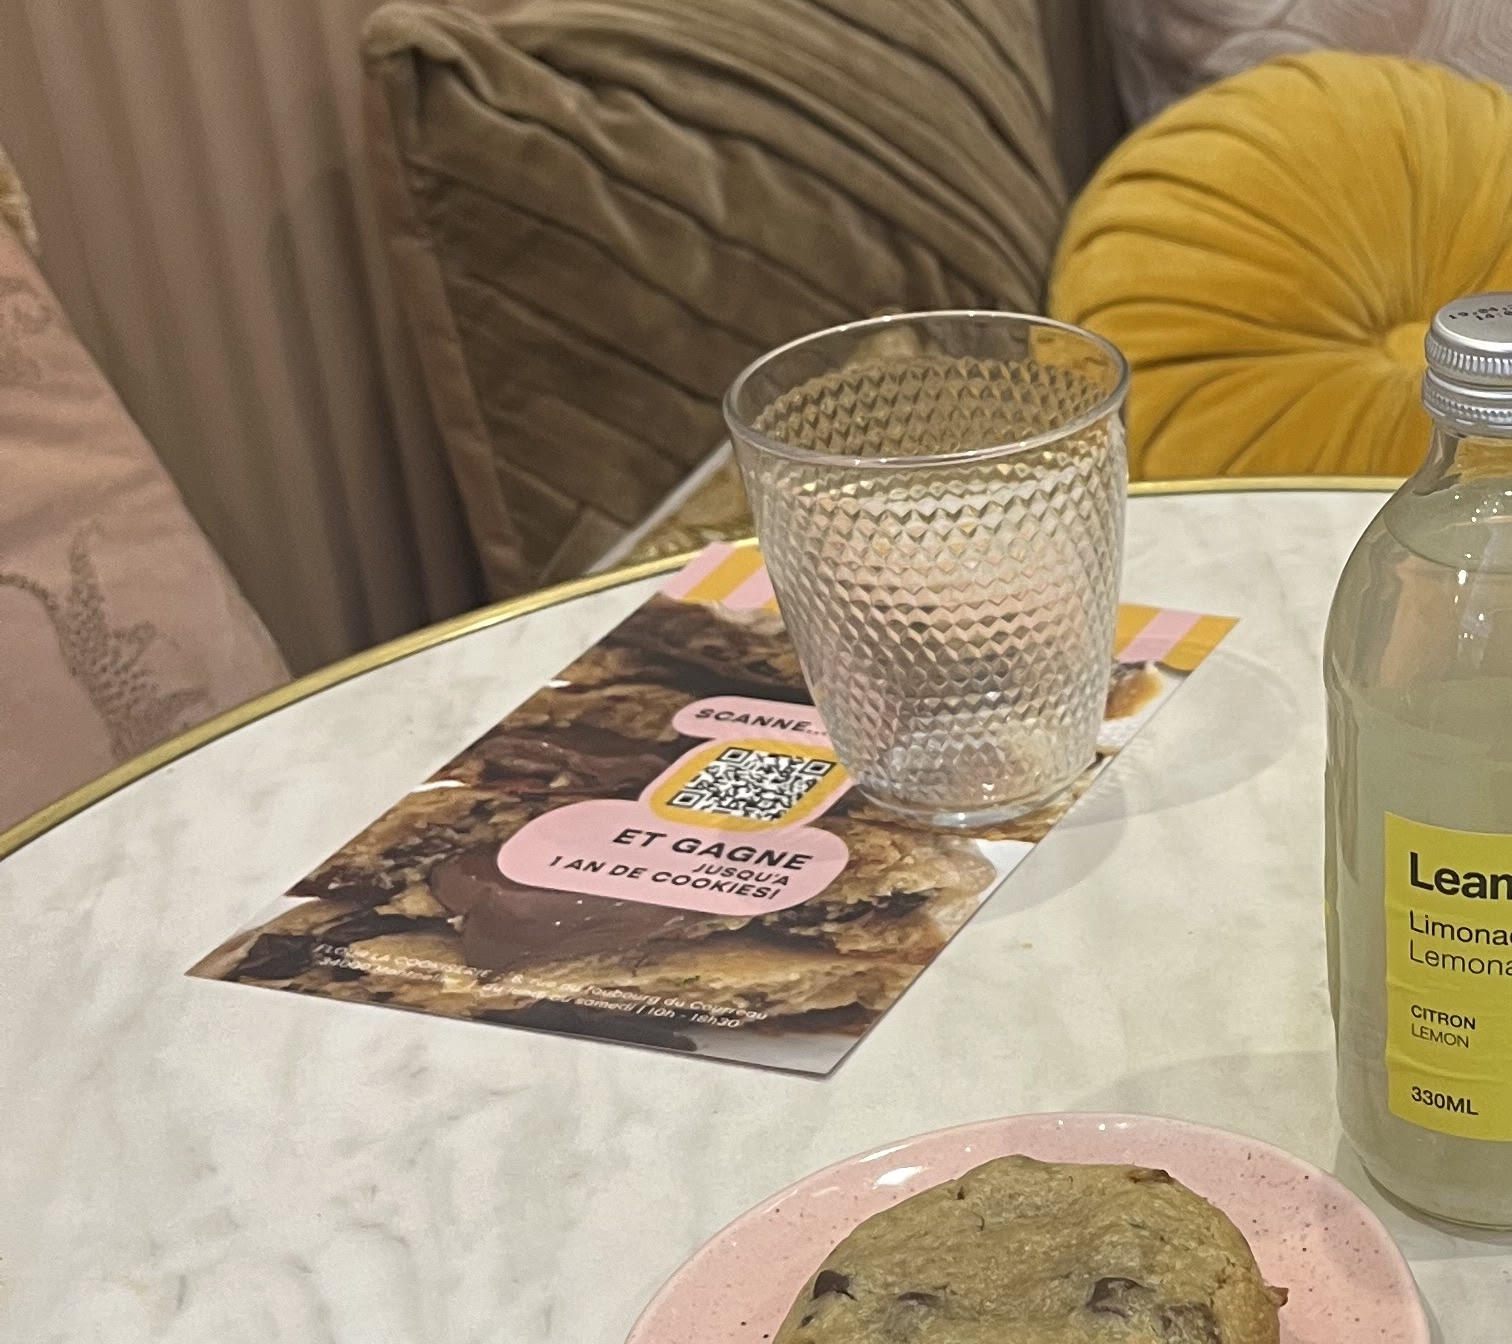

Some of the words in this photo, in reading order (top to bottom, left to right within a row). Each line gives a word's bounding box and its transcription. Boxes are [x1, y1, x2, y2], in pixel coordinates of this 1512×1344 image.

[612, 827, 667, 848] ET
[671, 837, 813, 871] GAGNE
[549, 855, 563, 867] 1
[564, 858, 606, 874] AN
[608, 863, 648, 880] DE
[651, 870, 781, 900] COOKIES!
[692, 862, 790, 887] JUSQU'A
[574, 997, 636, 1012] samedi
[664, 995, 686, 1008] du
[1410, 1004, 1476, 1030] CITRON
[1411, 1023, 1470, 1048] LEMON
[1410, 1086, 1479, 1116] 330ML
